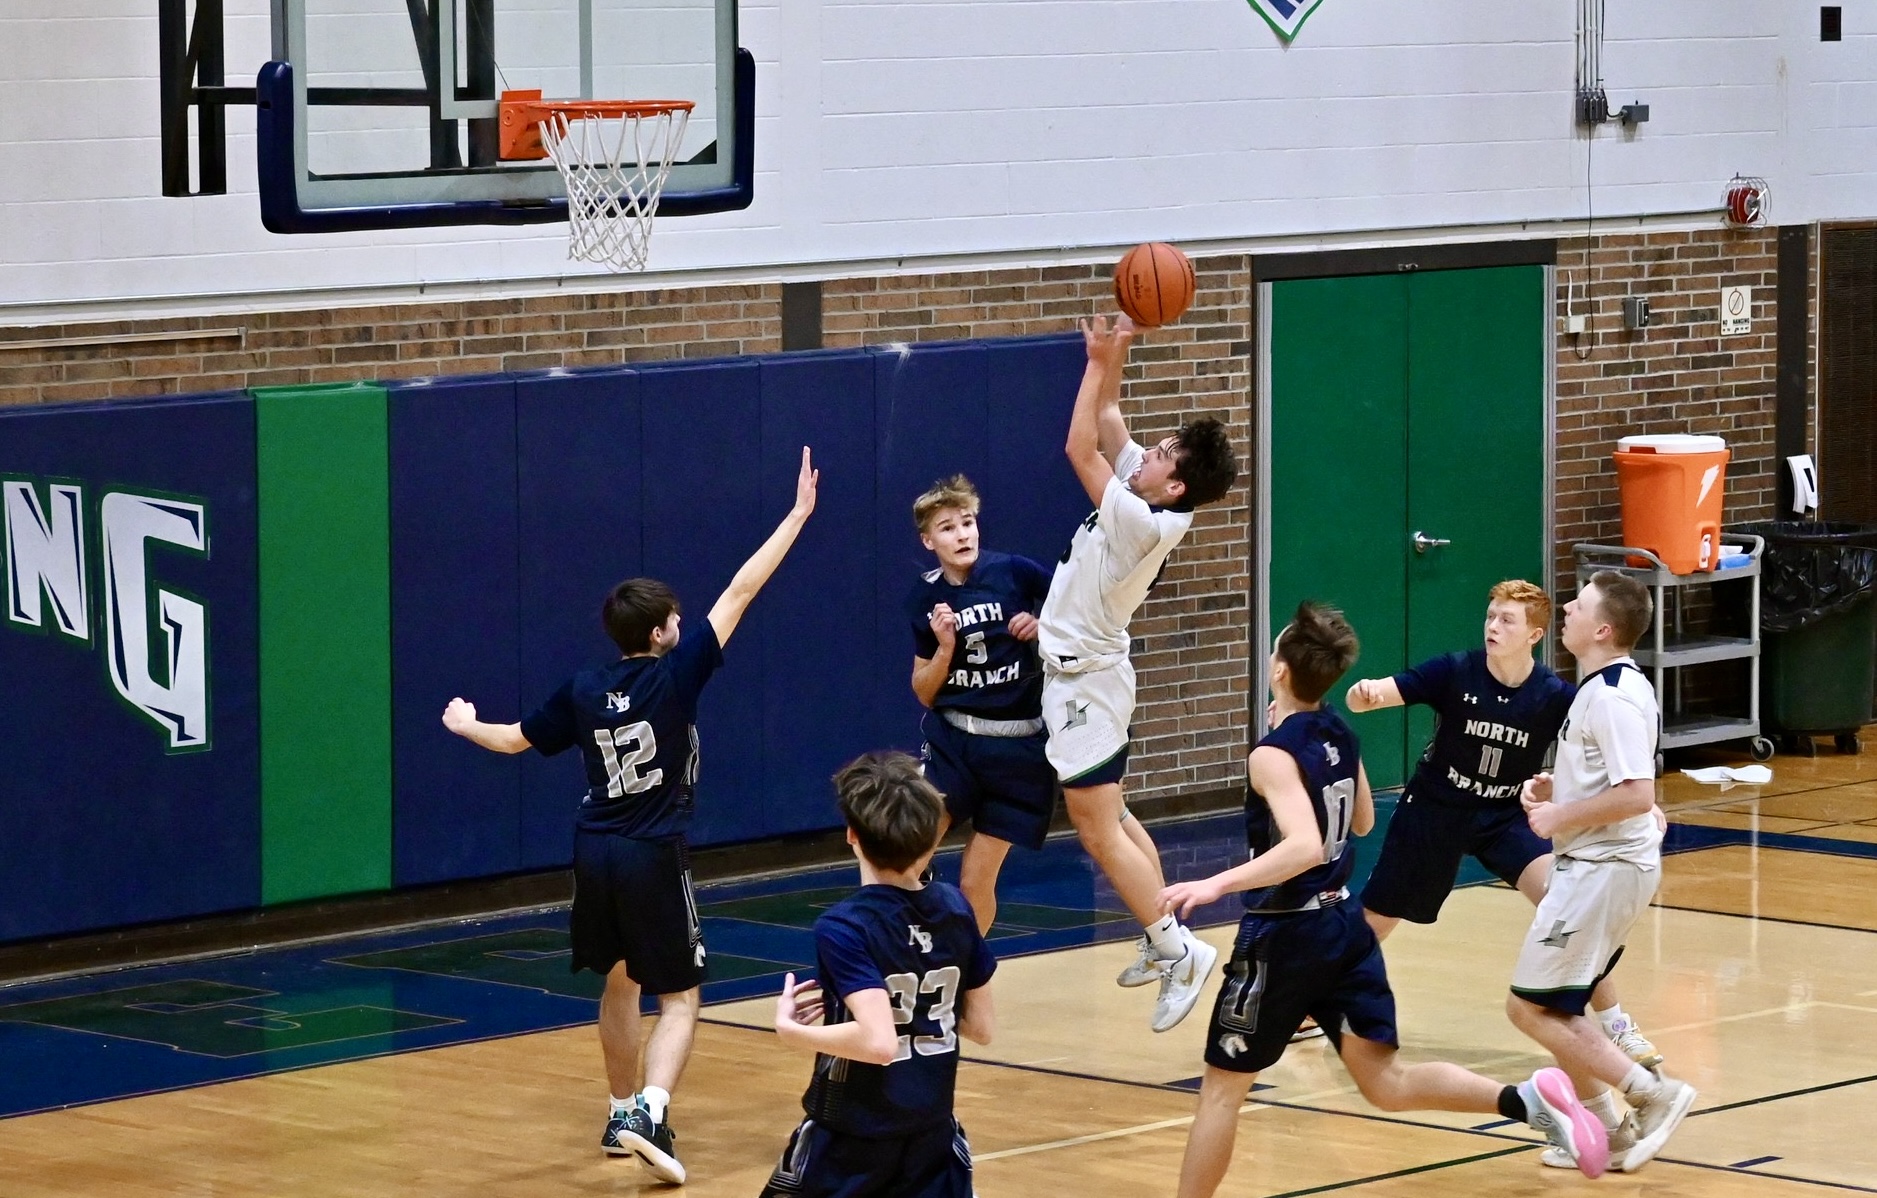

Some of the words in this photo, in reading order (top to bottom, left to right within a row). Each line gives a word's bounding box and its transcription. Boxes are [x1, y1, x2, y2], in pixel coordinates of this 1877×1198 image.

[954, 602, 1004, 632] ORTH
[965, 631, 988, 665] 5
[606, 691, 630, 713] NB
[1464, 719, 1530, 748] NORTH
[594, 720, 663, 798] 12
[1478, 744, 1503, 778] 11
[1447, 765, 1521, 799] BRANCH
[908, 924, 934, 953] NB
[881, 966, 961, 1066] 23
